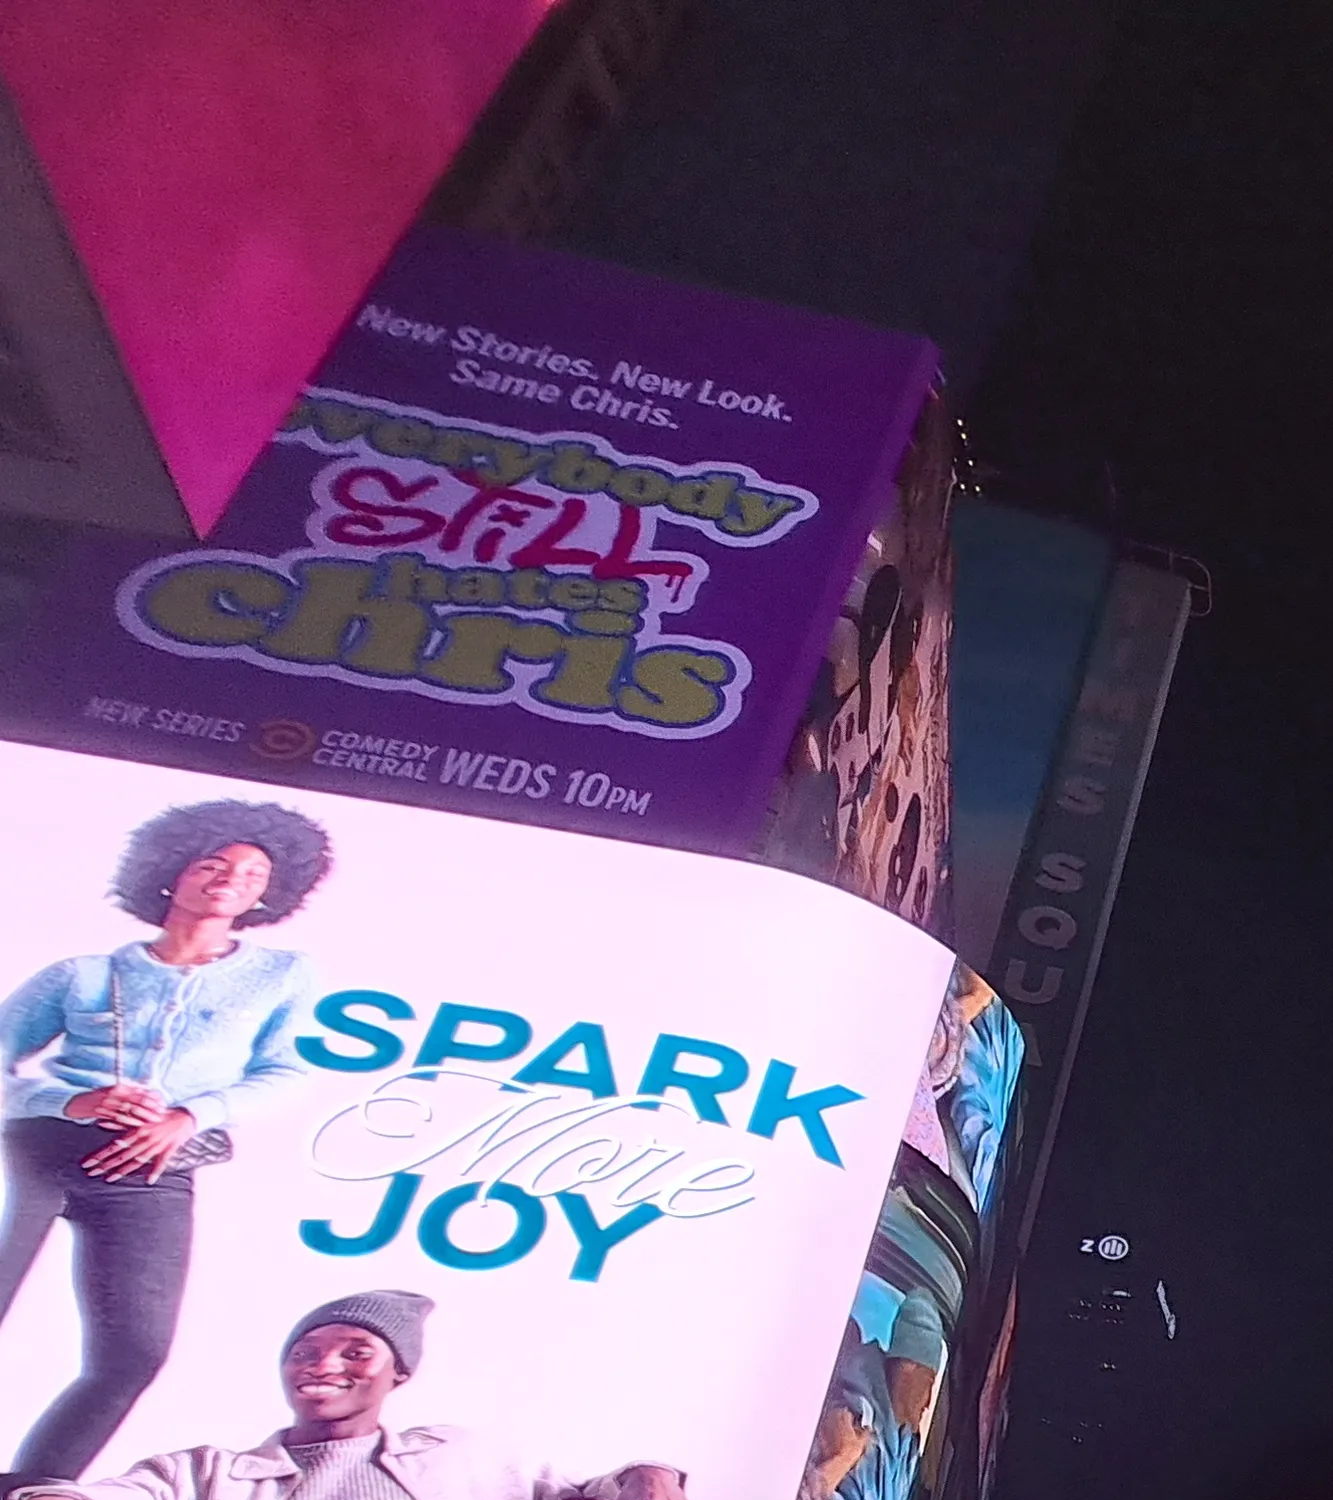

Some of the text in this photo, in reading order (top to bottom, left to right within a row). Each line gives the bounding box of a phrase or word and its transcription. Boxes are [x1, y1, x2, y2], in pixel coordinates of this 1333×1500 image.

[355, 305, 793, 424] New Stories. New Look.
[450, 359, 679, 431] Same Chris.
[274, 391, 810, 538] verybody
[380, 552, 646, 615] hates
[87, 697, 245, 743] NEW SERIES
[322, 729, 436, 762] COMEDY
[312, 748, 428, 783] CENTRAL
[439, 746, 556, 800] WEDS
[294, 987, 867, 1169] SPARK
[310, 1067, 757, 1219] More
[298, 1172, 665, 1284] JOY
